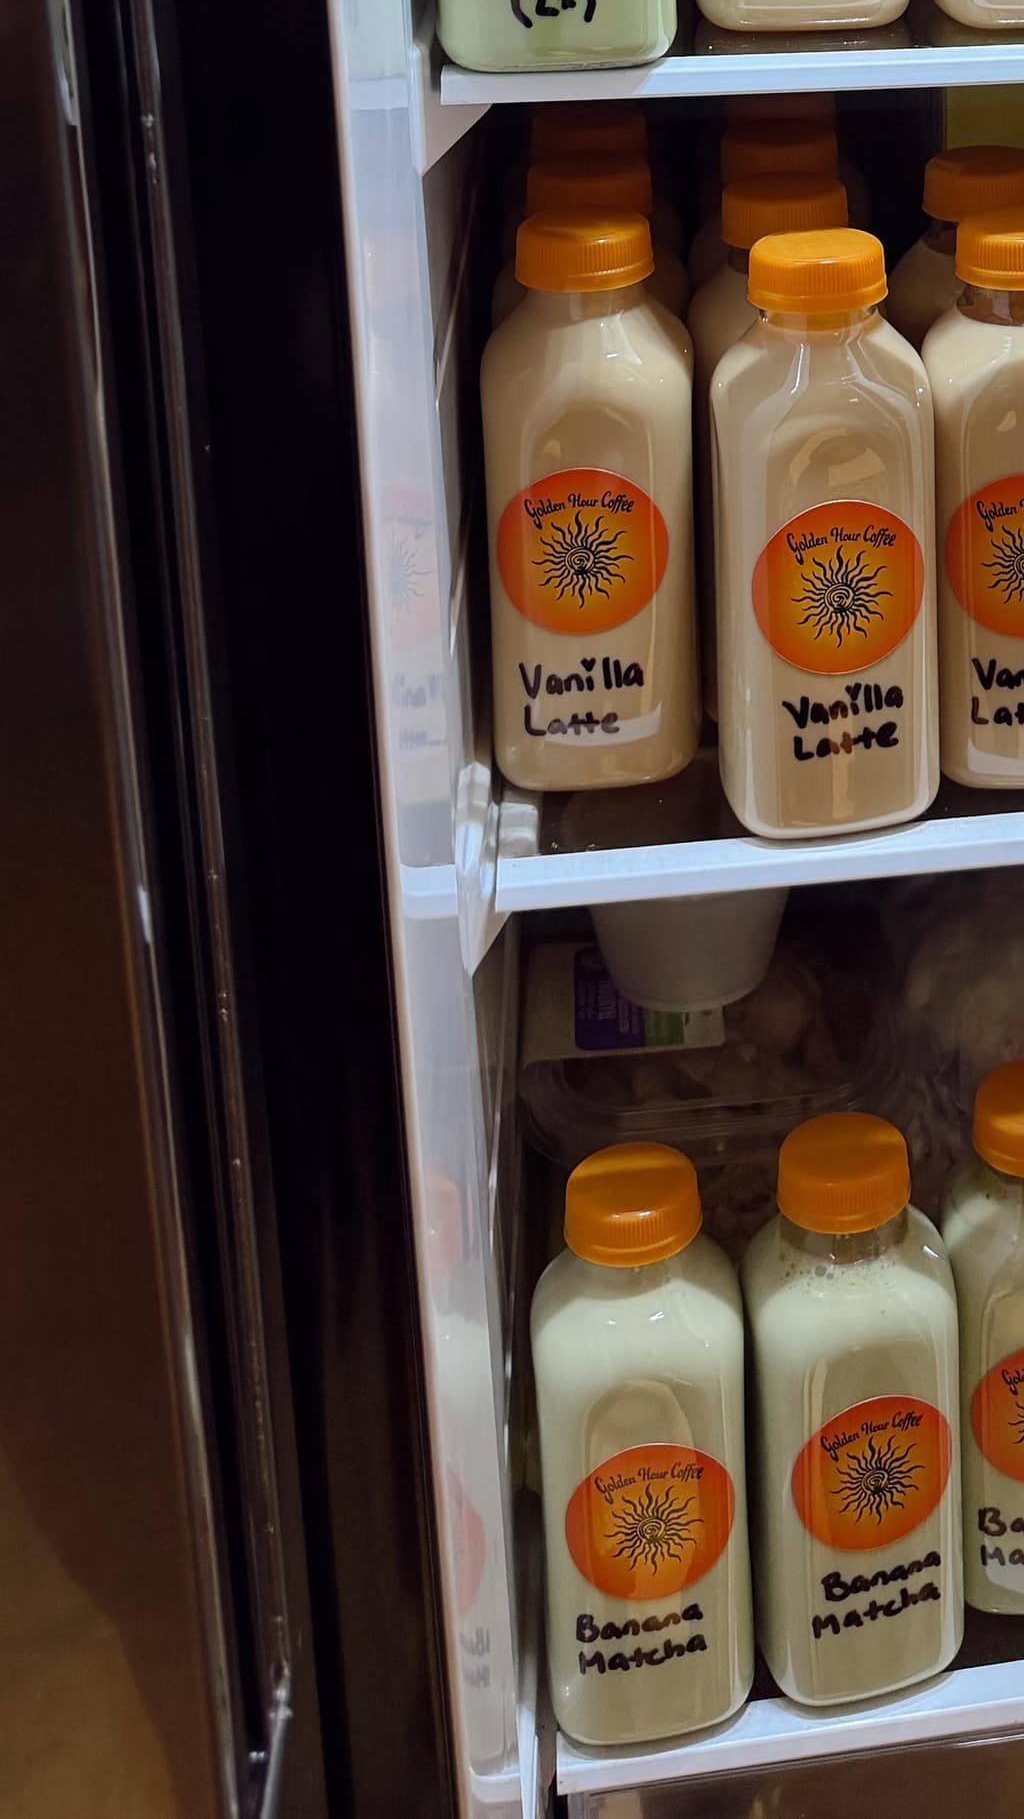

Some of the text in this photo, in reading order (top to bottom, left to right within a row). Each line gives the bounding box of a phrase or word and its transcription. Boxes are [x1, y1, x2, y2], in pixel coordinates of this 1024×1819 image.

[524, 492, 634, 528] Golden Hour Coffee
[976, 501, 1016, 531] Golden
[787, 525, 896, 564] Golden Hour Coffee
[519, 657, 644, 699] Vanilla
[525, 705, 619, 737] Latte
[783, 682, 904, 728] Vanilla
[794, 721, 899, 761] Latte
[821, 1550, 942, 1601] Banana
[576, 1603, 703, 1643] Banana
[812, 1581, 941, 1638] Matcha
[579, 1634, 707, 1675] Matcha
